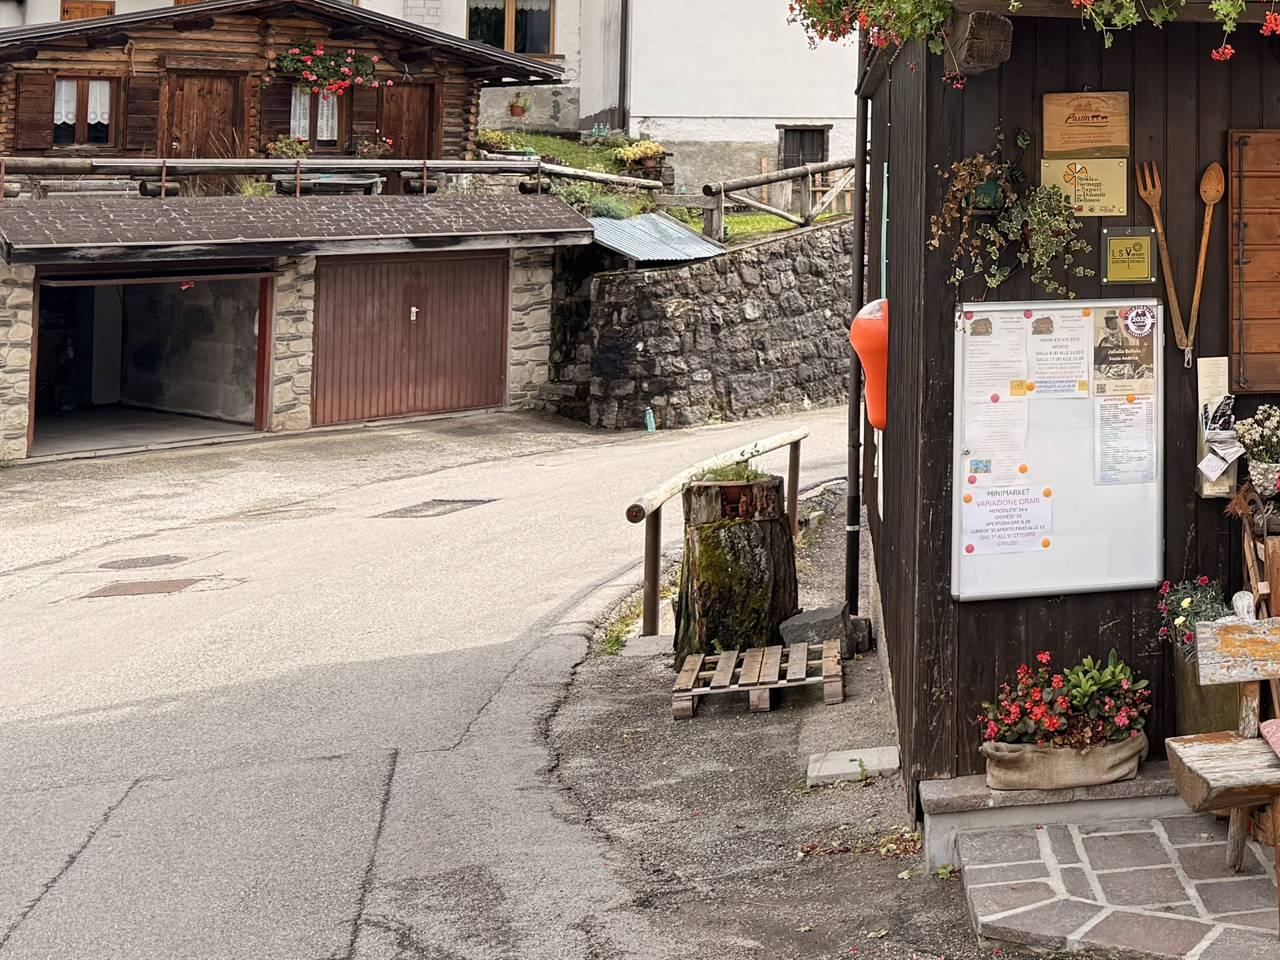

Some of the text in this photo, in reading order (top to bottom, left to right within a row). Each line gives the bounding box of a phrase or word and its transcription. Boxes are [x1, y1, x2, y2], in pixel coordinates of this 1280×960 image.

[987, 488, 1030, 497] MINIMARKET
[976, 497, 1040, 508] VARIAZIONE ORARI
